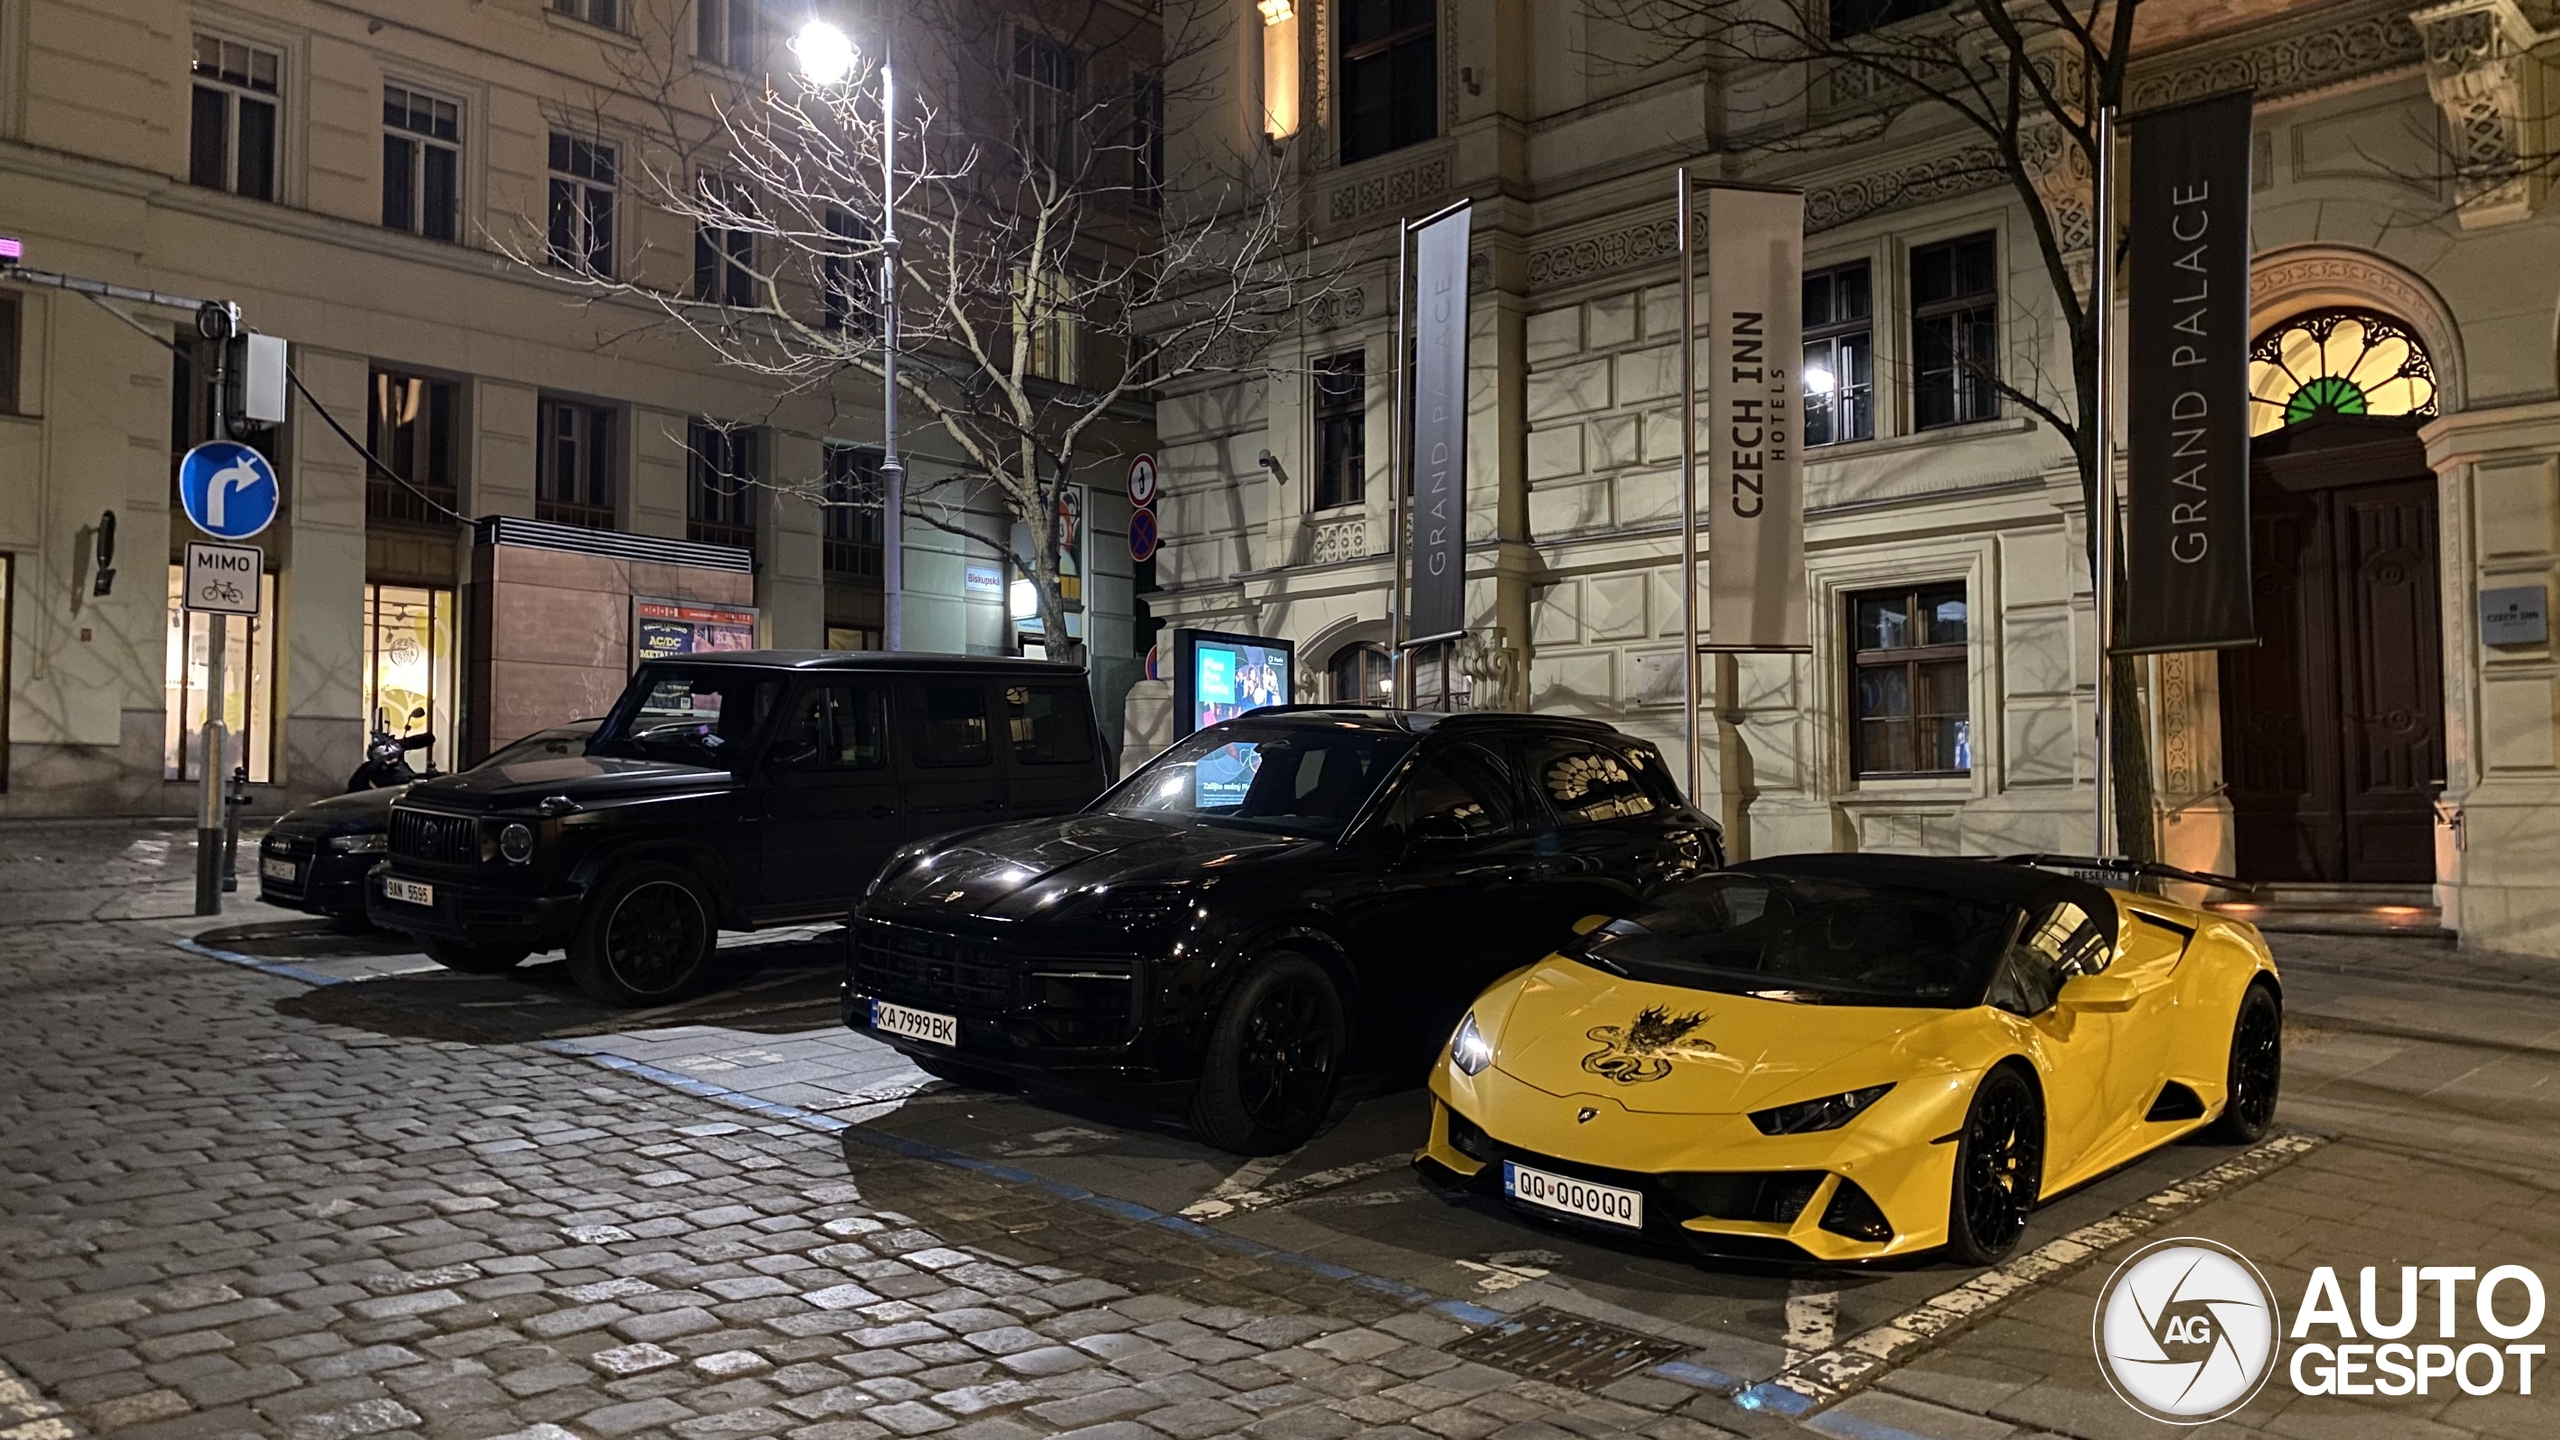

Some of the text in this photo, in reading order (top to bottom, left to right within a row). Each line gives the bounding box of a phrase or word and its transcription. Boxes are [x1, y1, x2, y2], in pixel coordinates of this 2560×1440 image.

[2172, 180, 2208, 564] GRAND PALACE
[1732, 312, 1763, 518] CZECH INN
[1771, 369, 1785, 460] HOTELS
[1429, 442, 1449, 575] GRAND
[198, 552, 250, 571] MIMO
[968, 573, 1000, 587] Biskupská
[649, 635, 682, 648] AC/DC
[388, 881, 428, 903] 9AN 5595
[879, 1005, 954, 1042] KA 7999 BK
